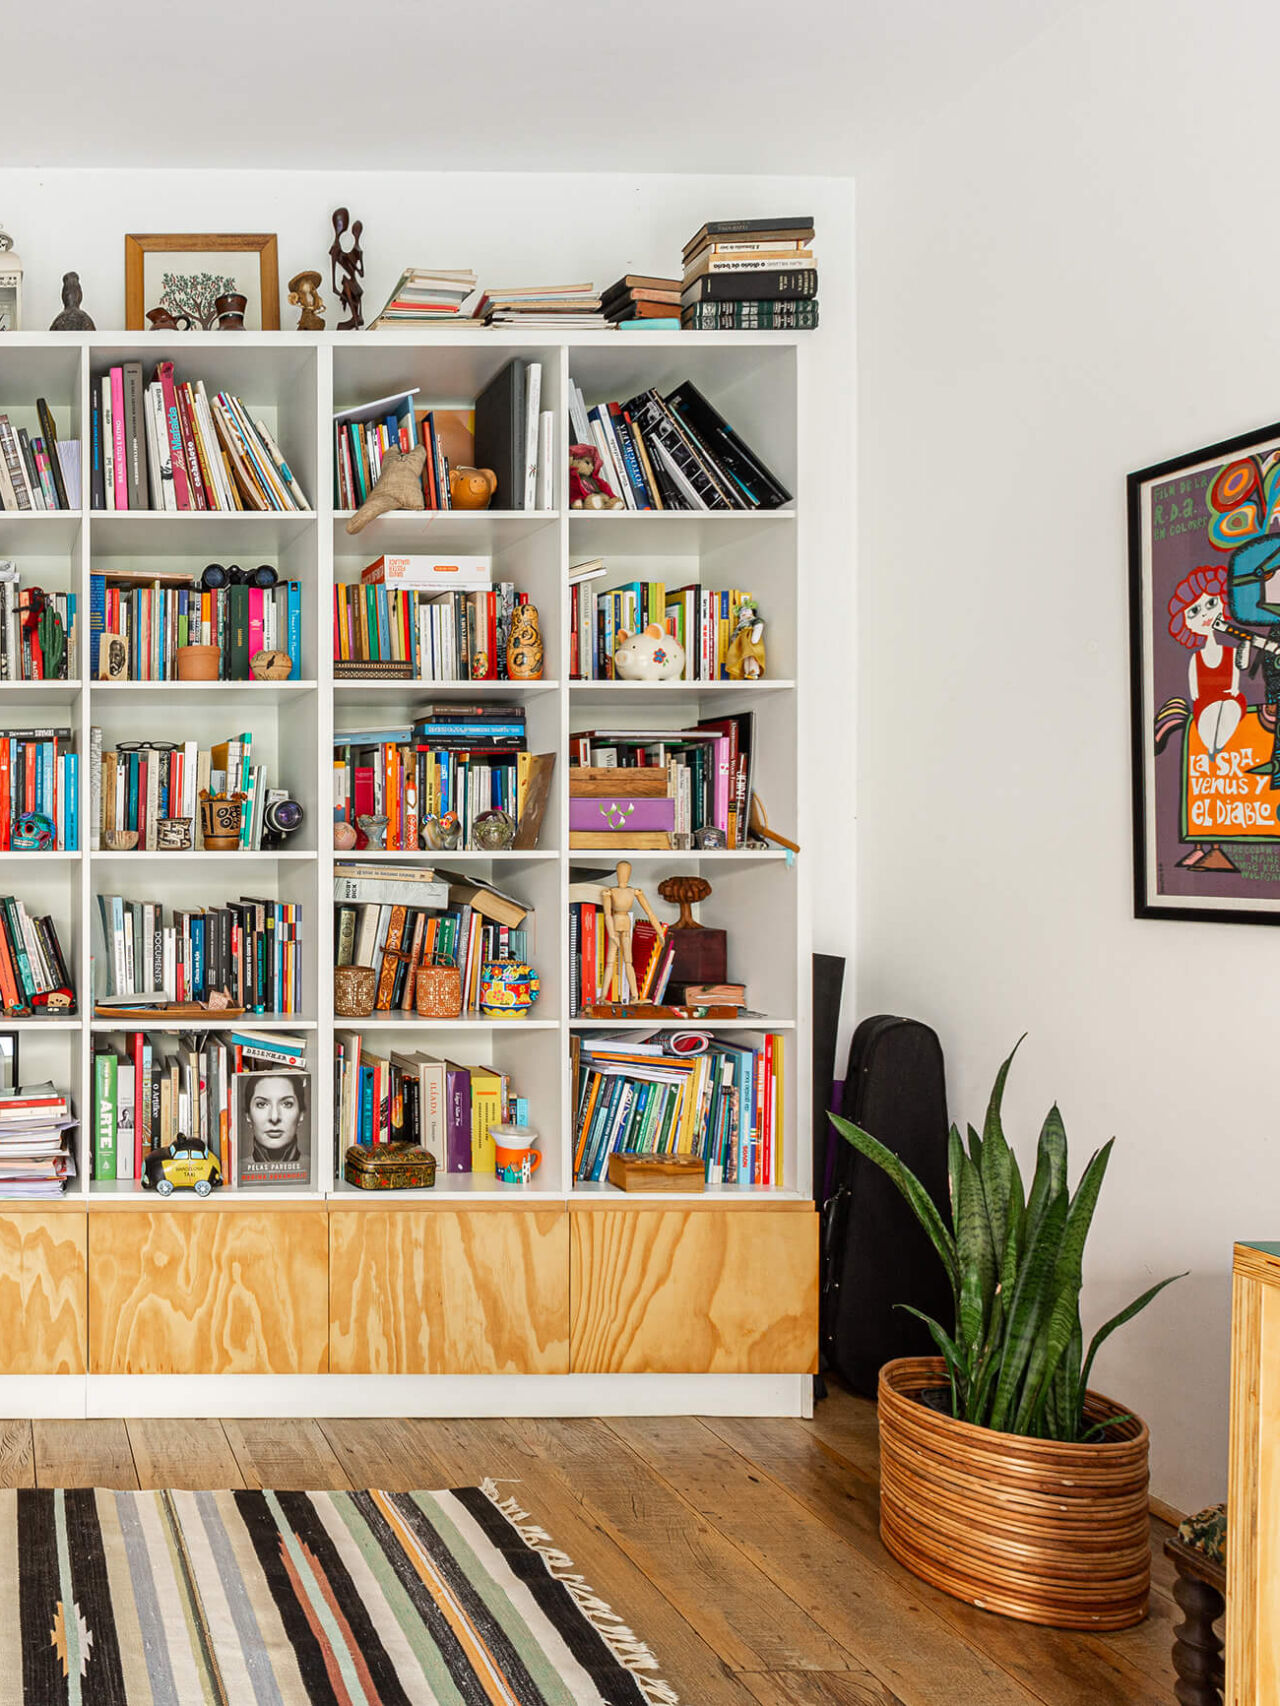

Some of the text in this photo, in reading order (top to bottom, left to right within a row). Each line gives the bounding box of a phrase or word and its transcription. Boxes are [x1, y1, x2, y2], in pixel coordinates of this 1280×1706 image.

[169, 406, 182, 450] Mafalda
[1154, 485, 1175, 502] FILM
[1180, 479, 1192, 494] DE
[154, 931, 162, 983] DOCUMENTS
[430, 1082, 439, 1115] ILÍADA
[100, 1099, 112, 1149] ARTE
[247, 1163, 300, 1171] PELAS PAREDES
